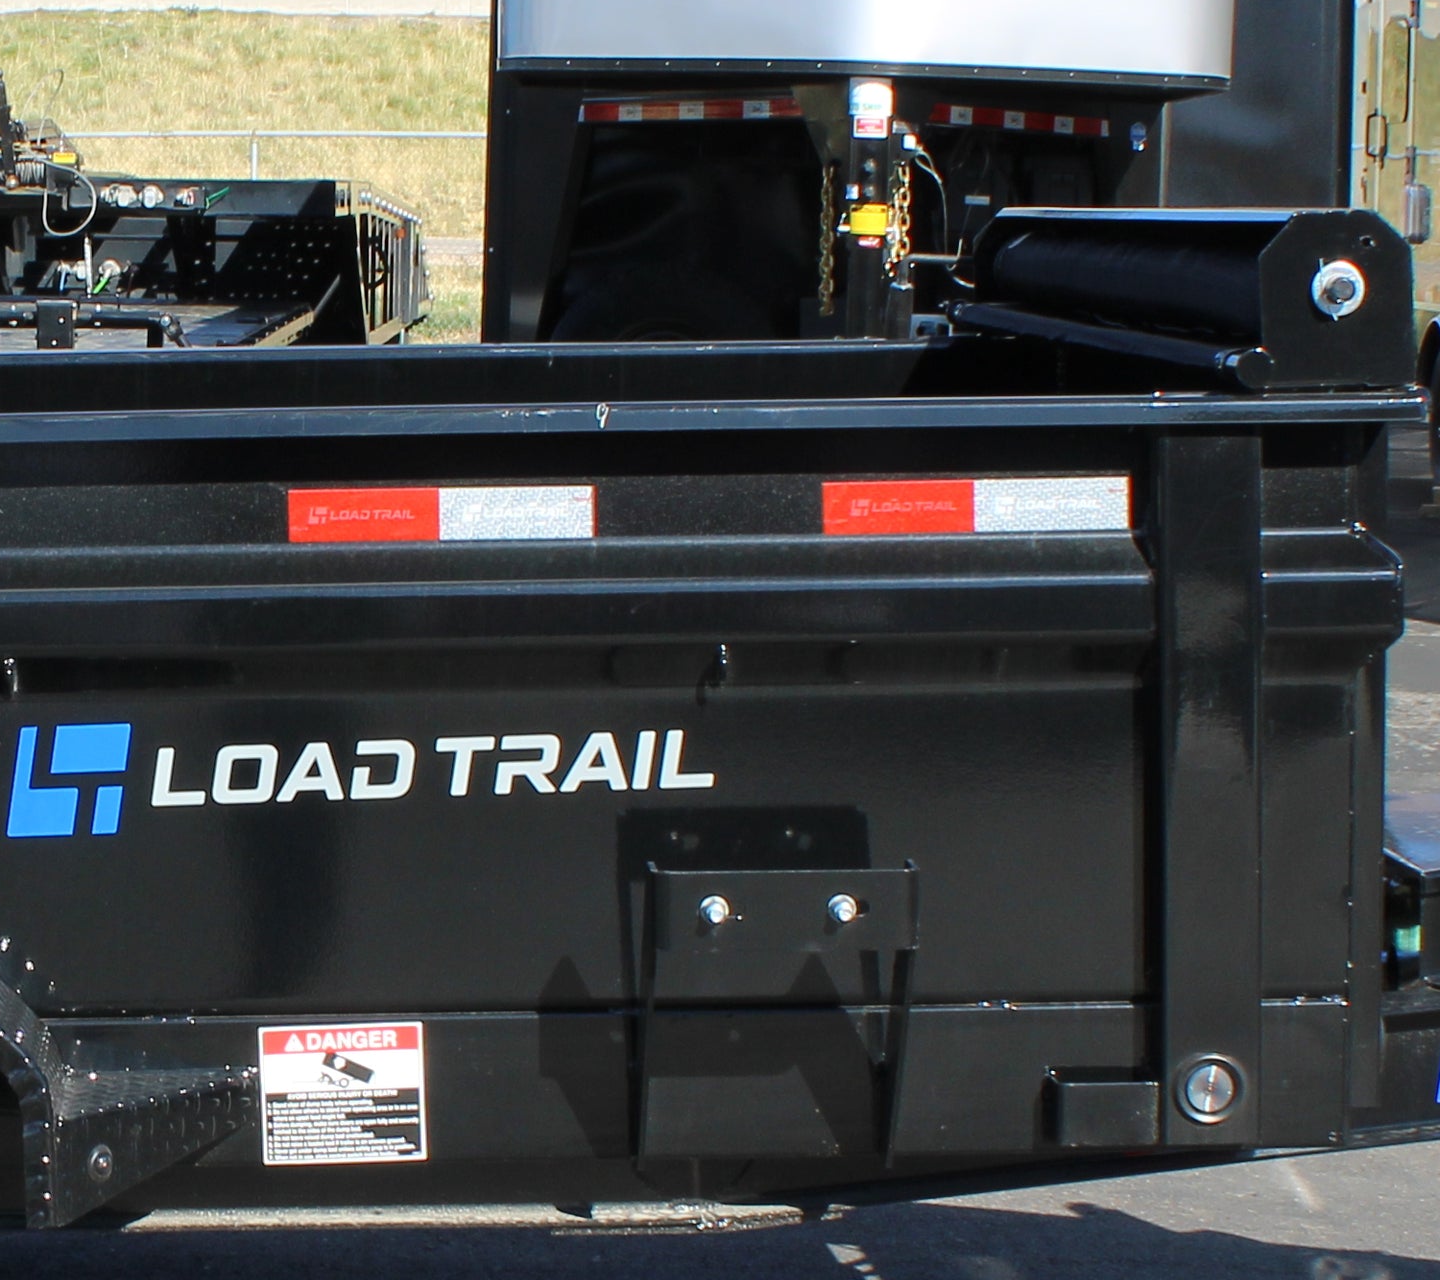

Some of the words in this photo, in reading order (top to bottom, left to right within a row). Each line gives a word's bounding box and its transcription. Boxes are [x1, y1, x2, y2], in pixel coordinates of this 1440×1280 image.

[330, 509, 370, 521] LOAD
[372, 508, 415, 520] TRAIL
[872, 502, 912, 513] LOAD
[914, 500, 957, 512] TRAIL
[150, 738, 416, 807] LOAD
[434, 729, 716, 797] TRAIL
[305, 1030, 398, 1051] DANGER
